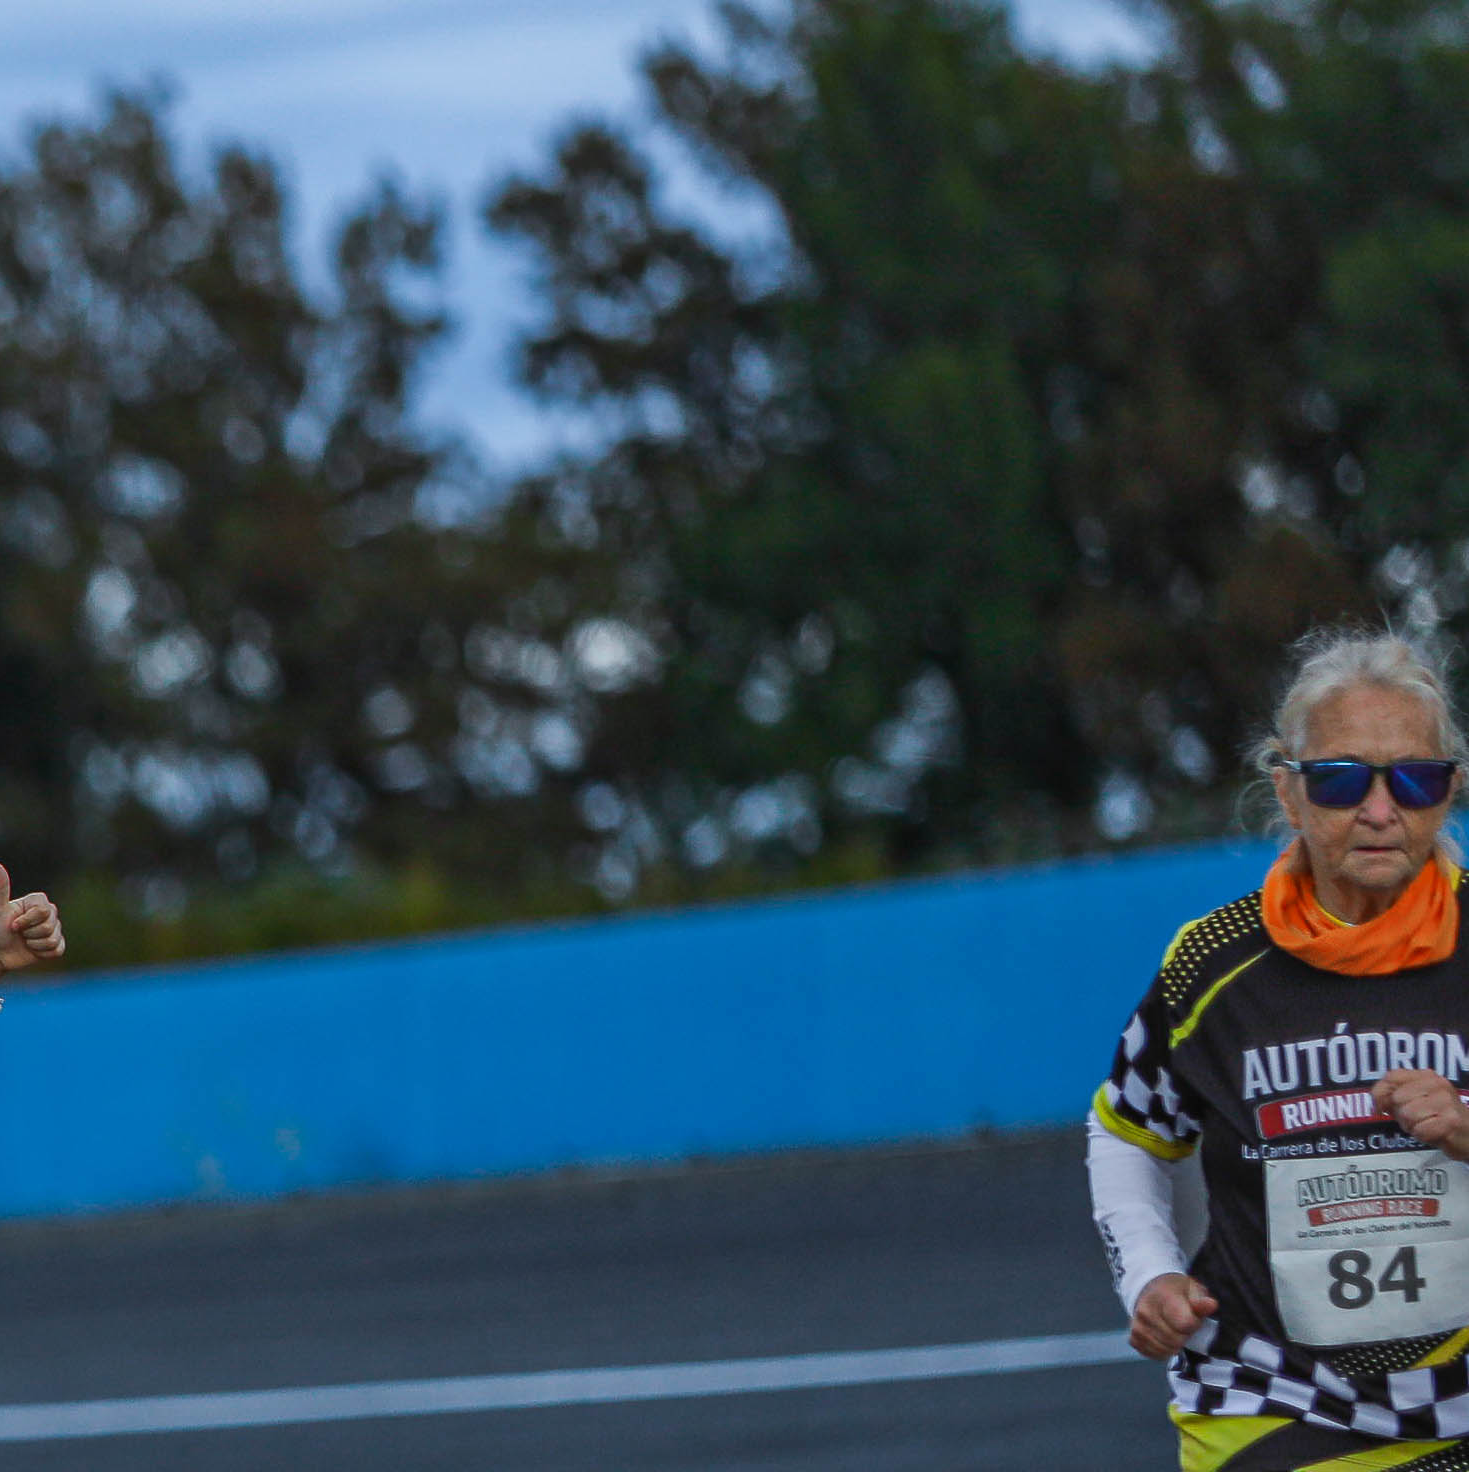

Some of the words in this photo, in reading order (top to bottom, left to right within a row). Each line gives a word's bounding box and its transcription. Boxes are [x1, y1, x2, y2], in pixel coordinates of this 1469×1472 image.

[1281, 1092, 1376, 1130] RUNNIN
[1242, 1143, 1259, 1159] La
[1262, 1140, 1313, 1159] Carrera
[1316, 1137, 1338, 1153] de
[1340, 1135, 1366, 1151] los
[1297, 1164, 1448, 1207] AUTÓDROMO
[1322, 1202, 1383, 1222] RUNNING
[1388, 1199, 1423, 1215] RACE
[1329, 1246, 1426, 1309] 84
